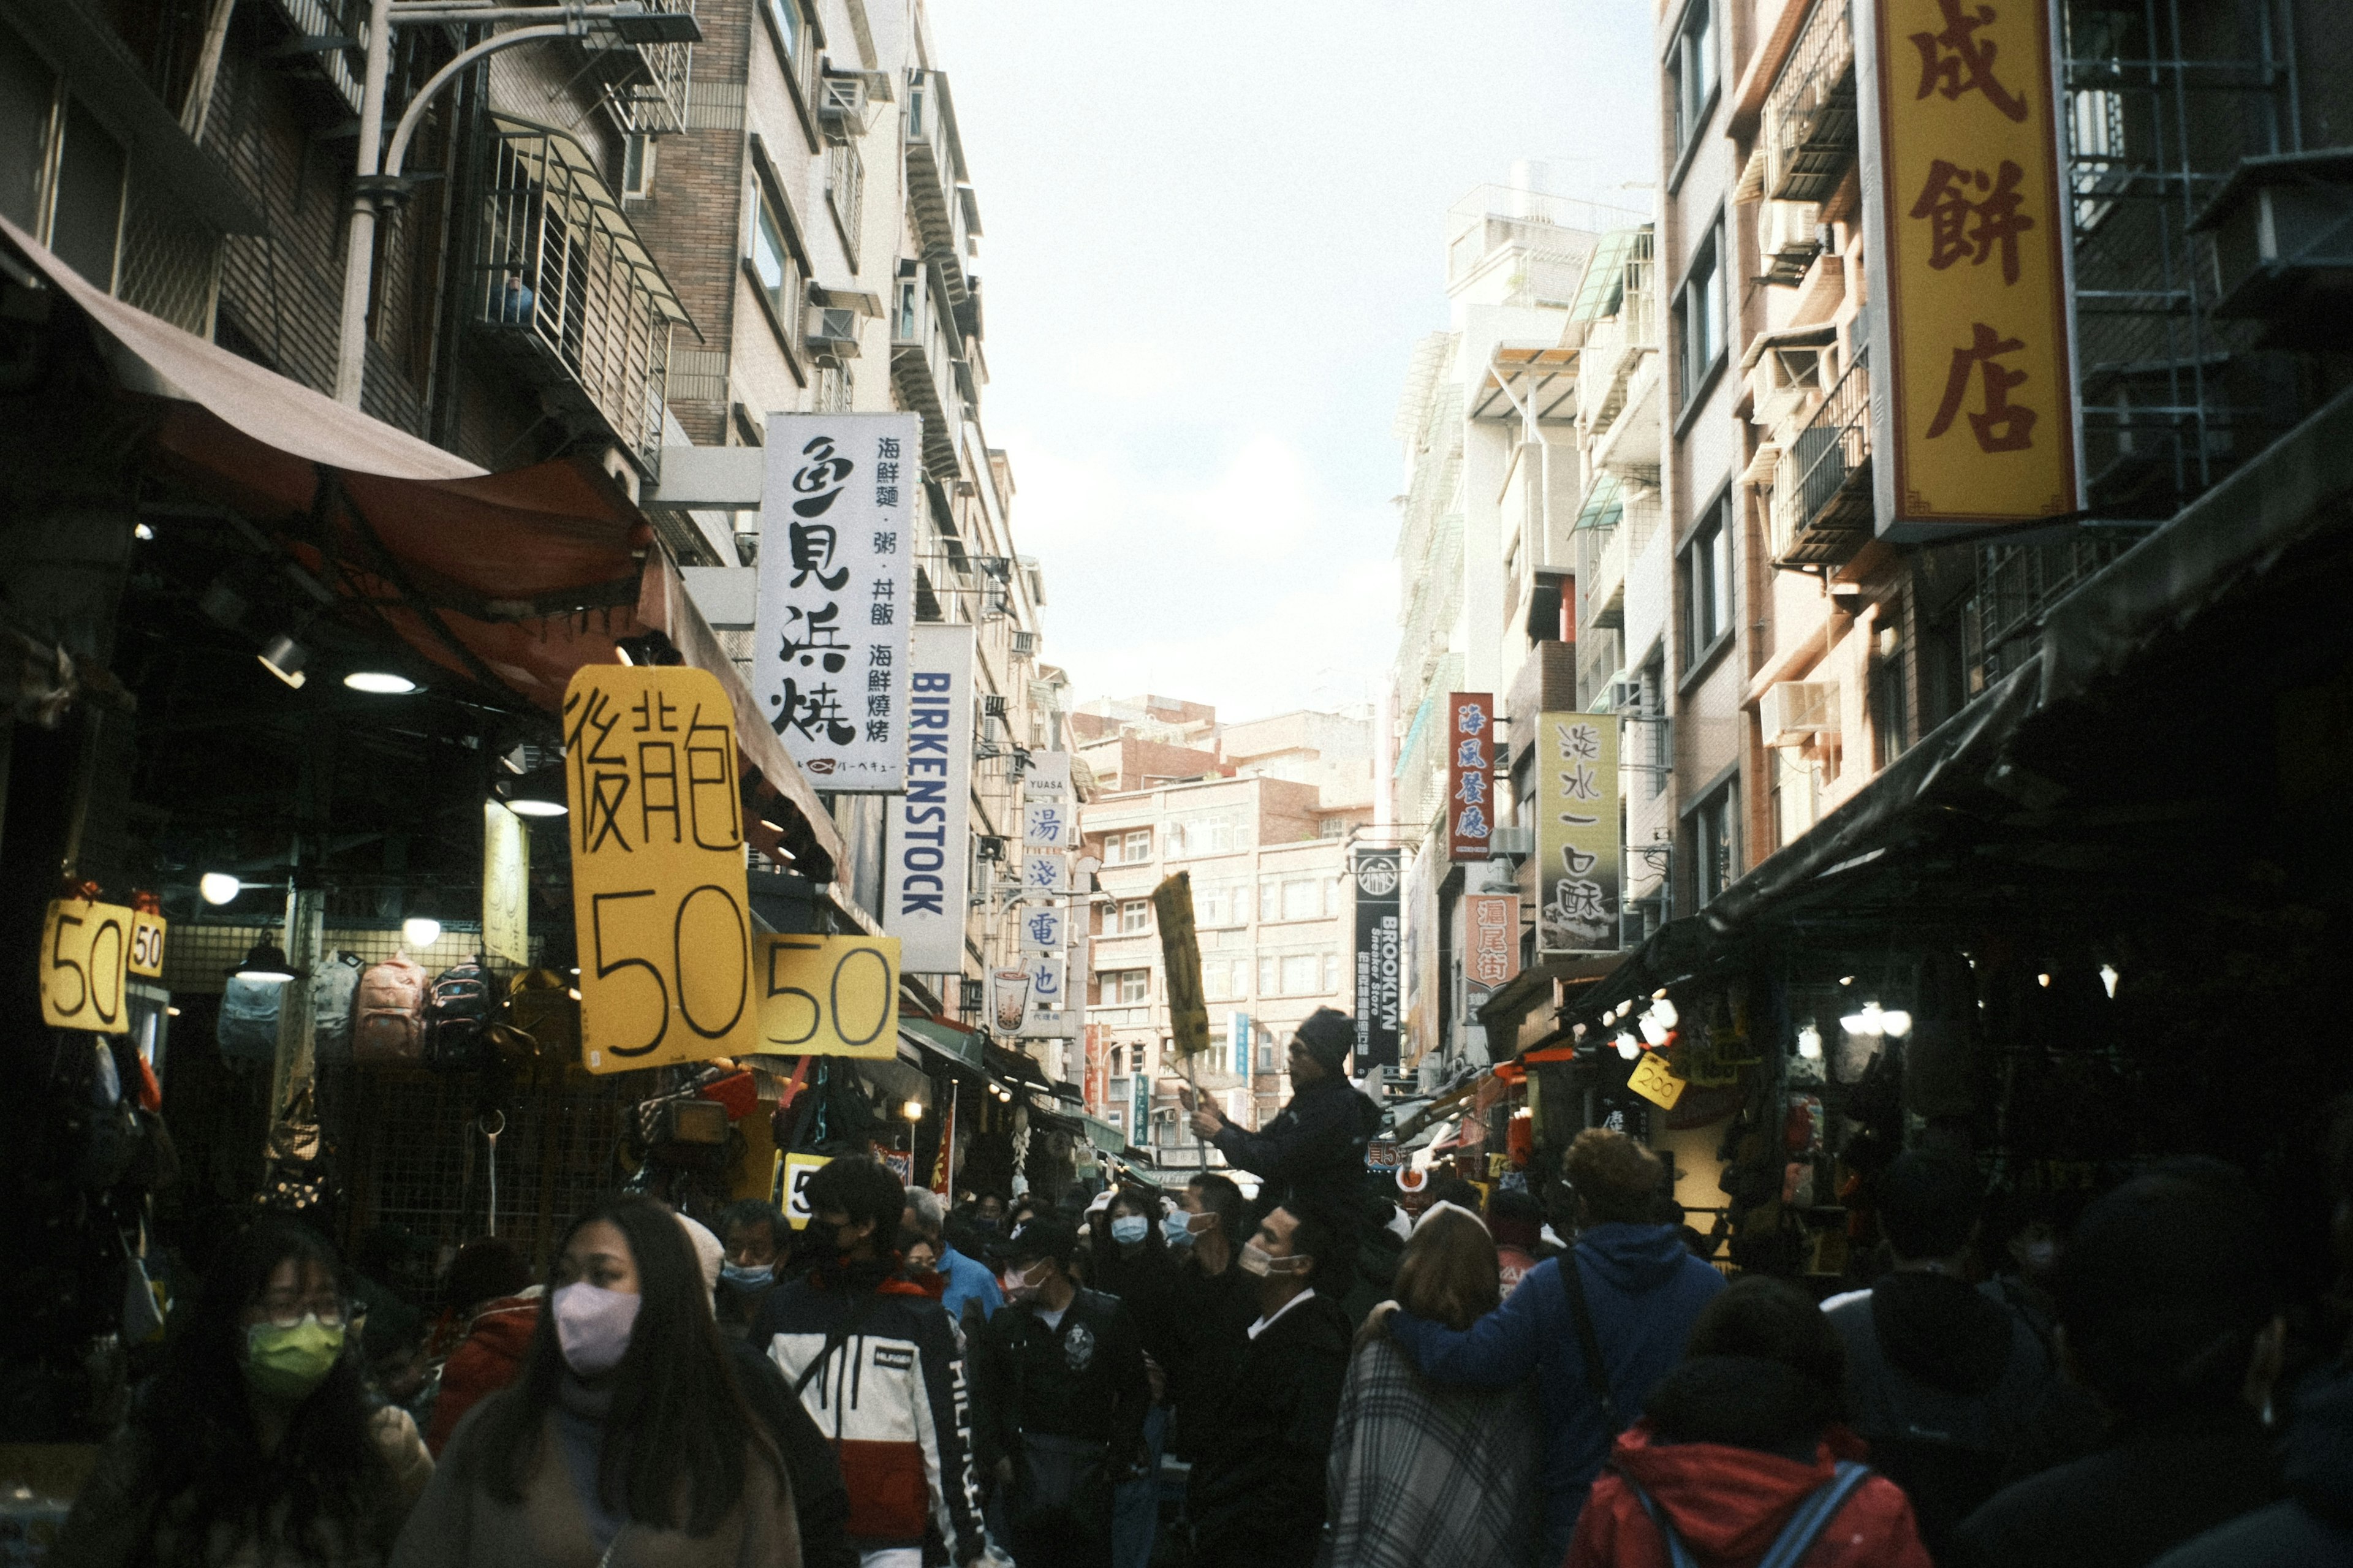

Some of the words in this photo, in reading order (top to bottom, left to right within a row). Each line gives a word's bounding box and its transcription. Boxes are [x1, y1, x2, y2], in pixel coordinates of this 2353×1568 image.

[866, 644, 892, 743] 海鮮燒烤
[564, 686, 742, 854] 後背包
[902, 673, 952, 916] BIRKENSTOCK
[1030, 780, 1063, 790] YUASA
[1455, 703, 1488, 839] 海風餐廳
[1556, 723, 1604, 920] 淡水一口酥
[53, 913, 123, 1025] 50
[133, 925, 162, 968] 50
[592, 884, 747, 1057] 50
[1371, 928, 1381, 979] Sneaker
[1381, 915, 1398, 1031] BROOKLYN
[1477, 898, 1508, 981] 滬尾街
[767, 942, 892, 1045] 50
[1371, 982, 1381, 1016] Store
[1637, 1067, 1673, 1099] 200
